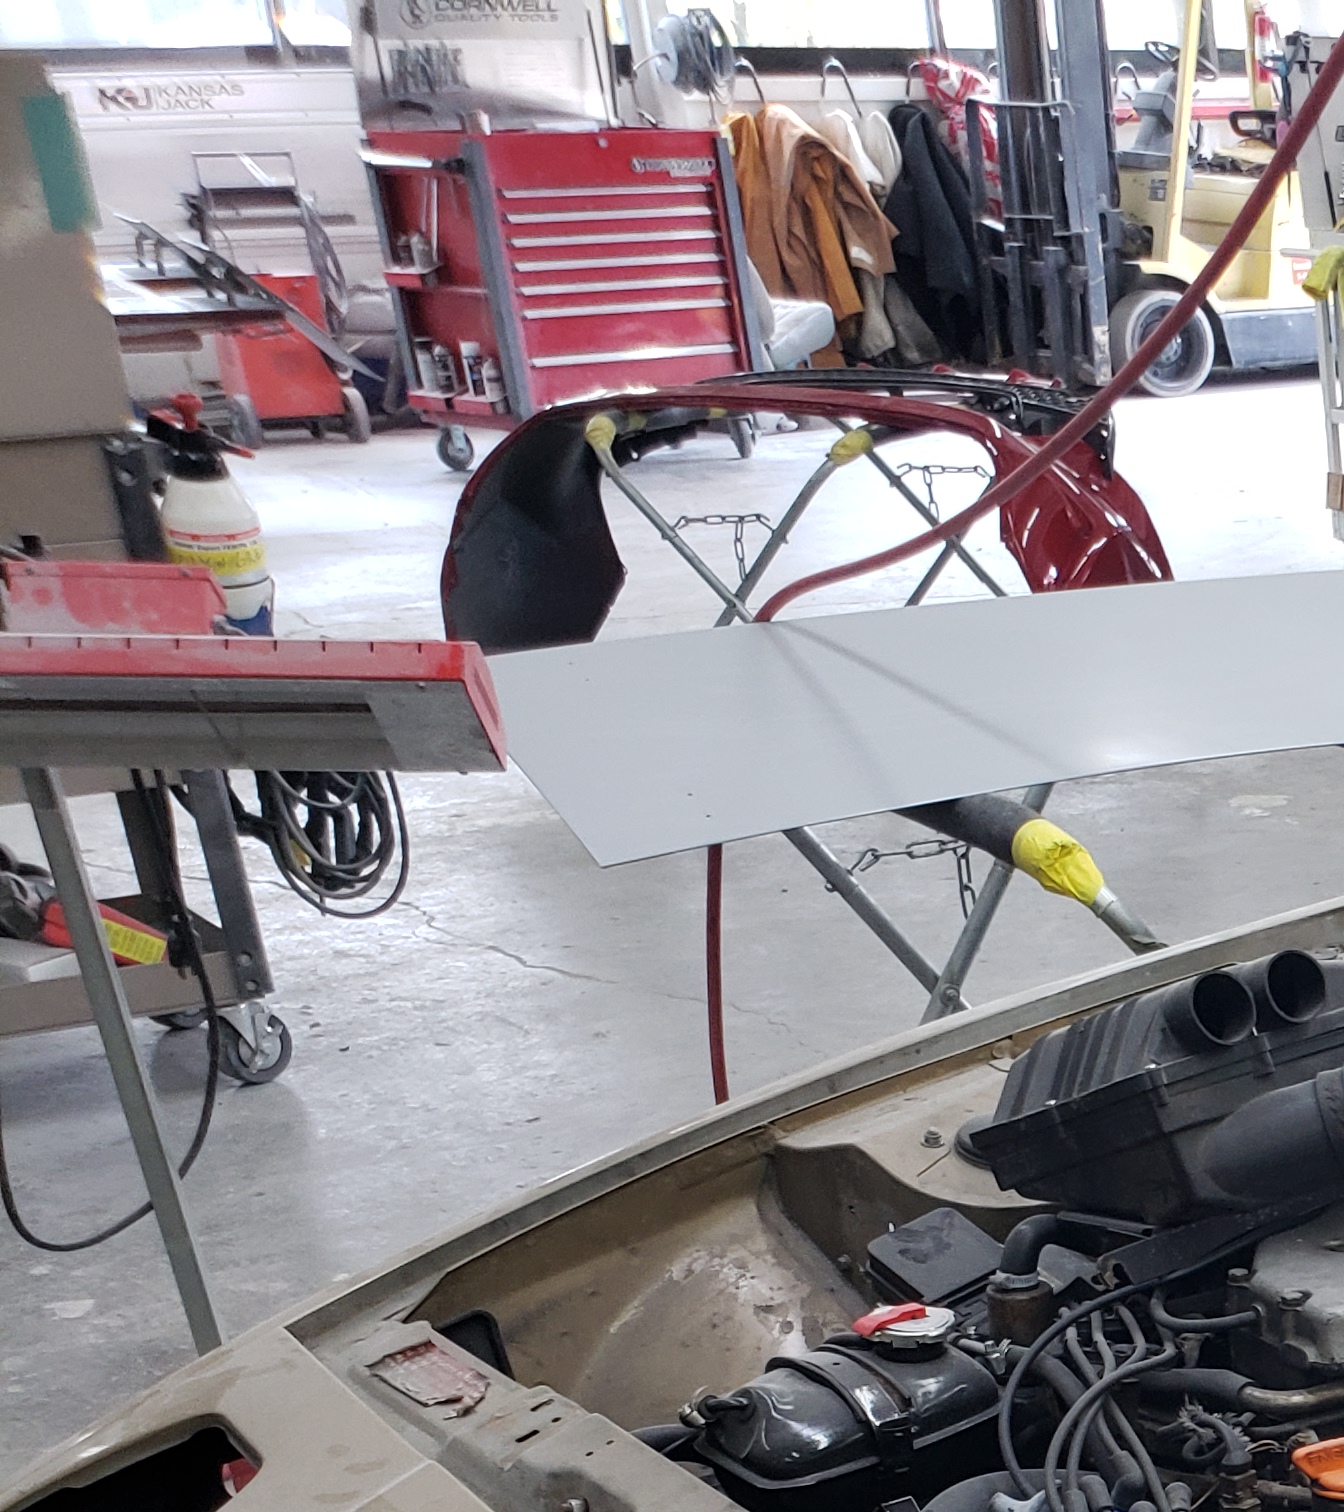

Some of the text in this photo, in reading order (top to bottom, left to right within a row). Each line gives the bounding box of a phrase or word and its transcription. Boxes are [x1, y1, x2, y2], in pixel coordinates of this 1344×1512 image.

[435, 0, 558, 11] CORNWELL
[433, 13, 559, 22] QUALITY TOOLS
[157, 84, 245, 98] KANSAS
[160, 98, 214, 111] JACK
